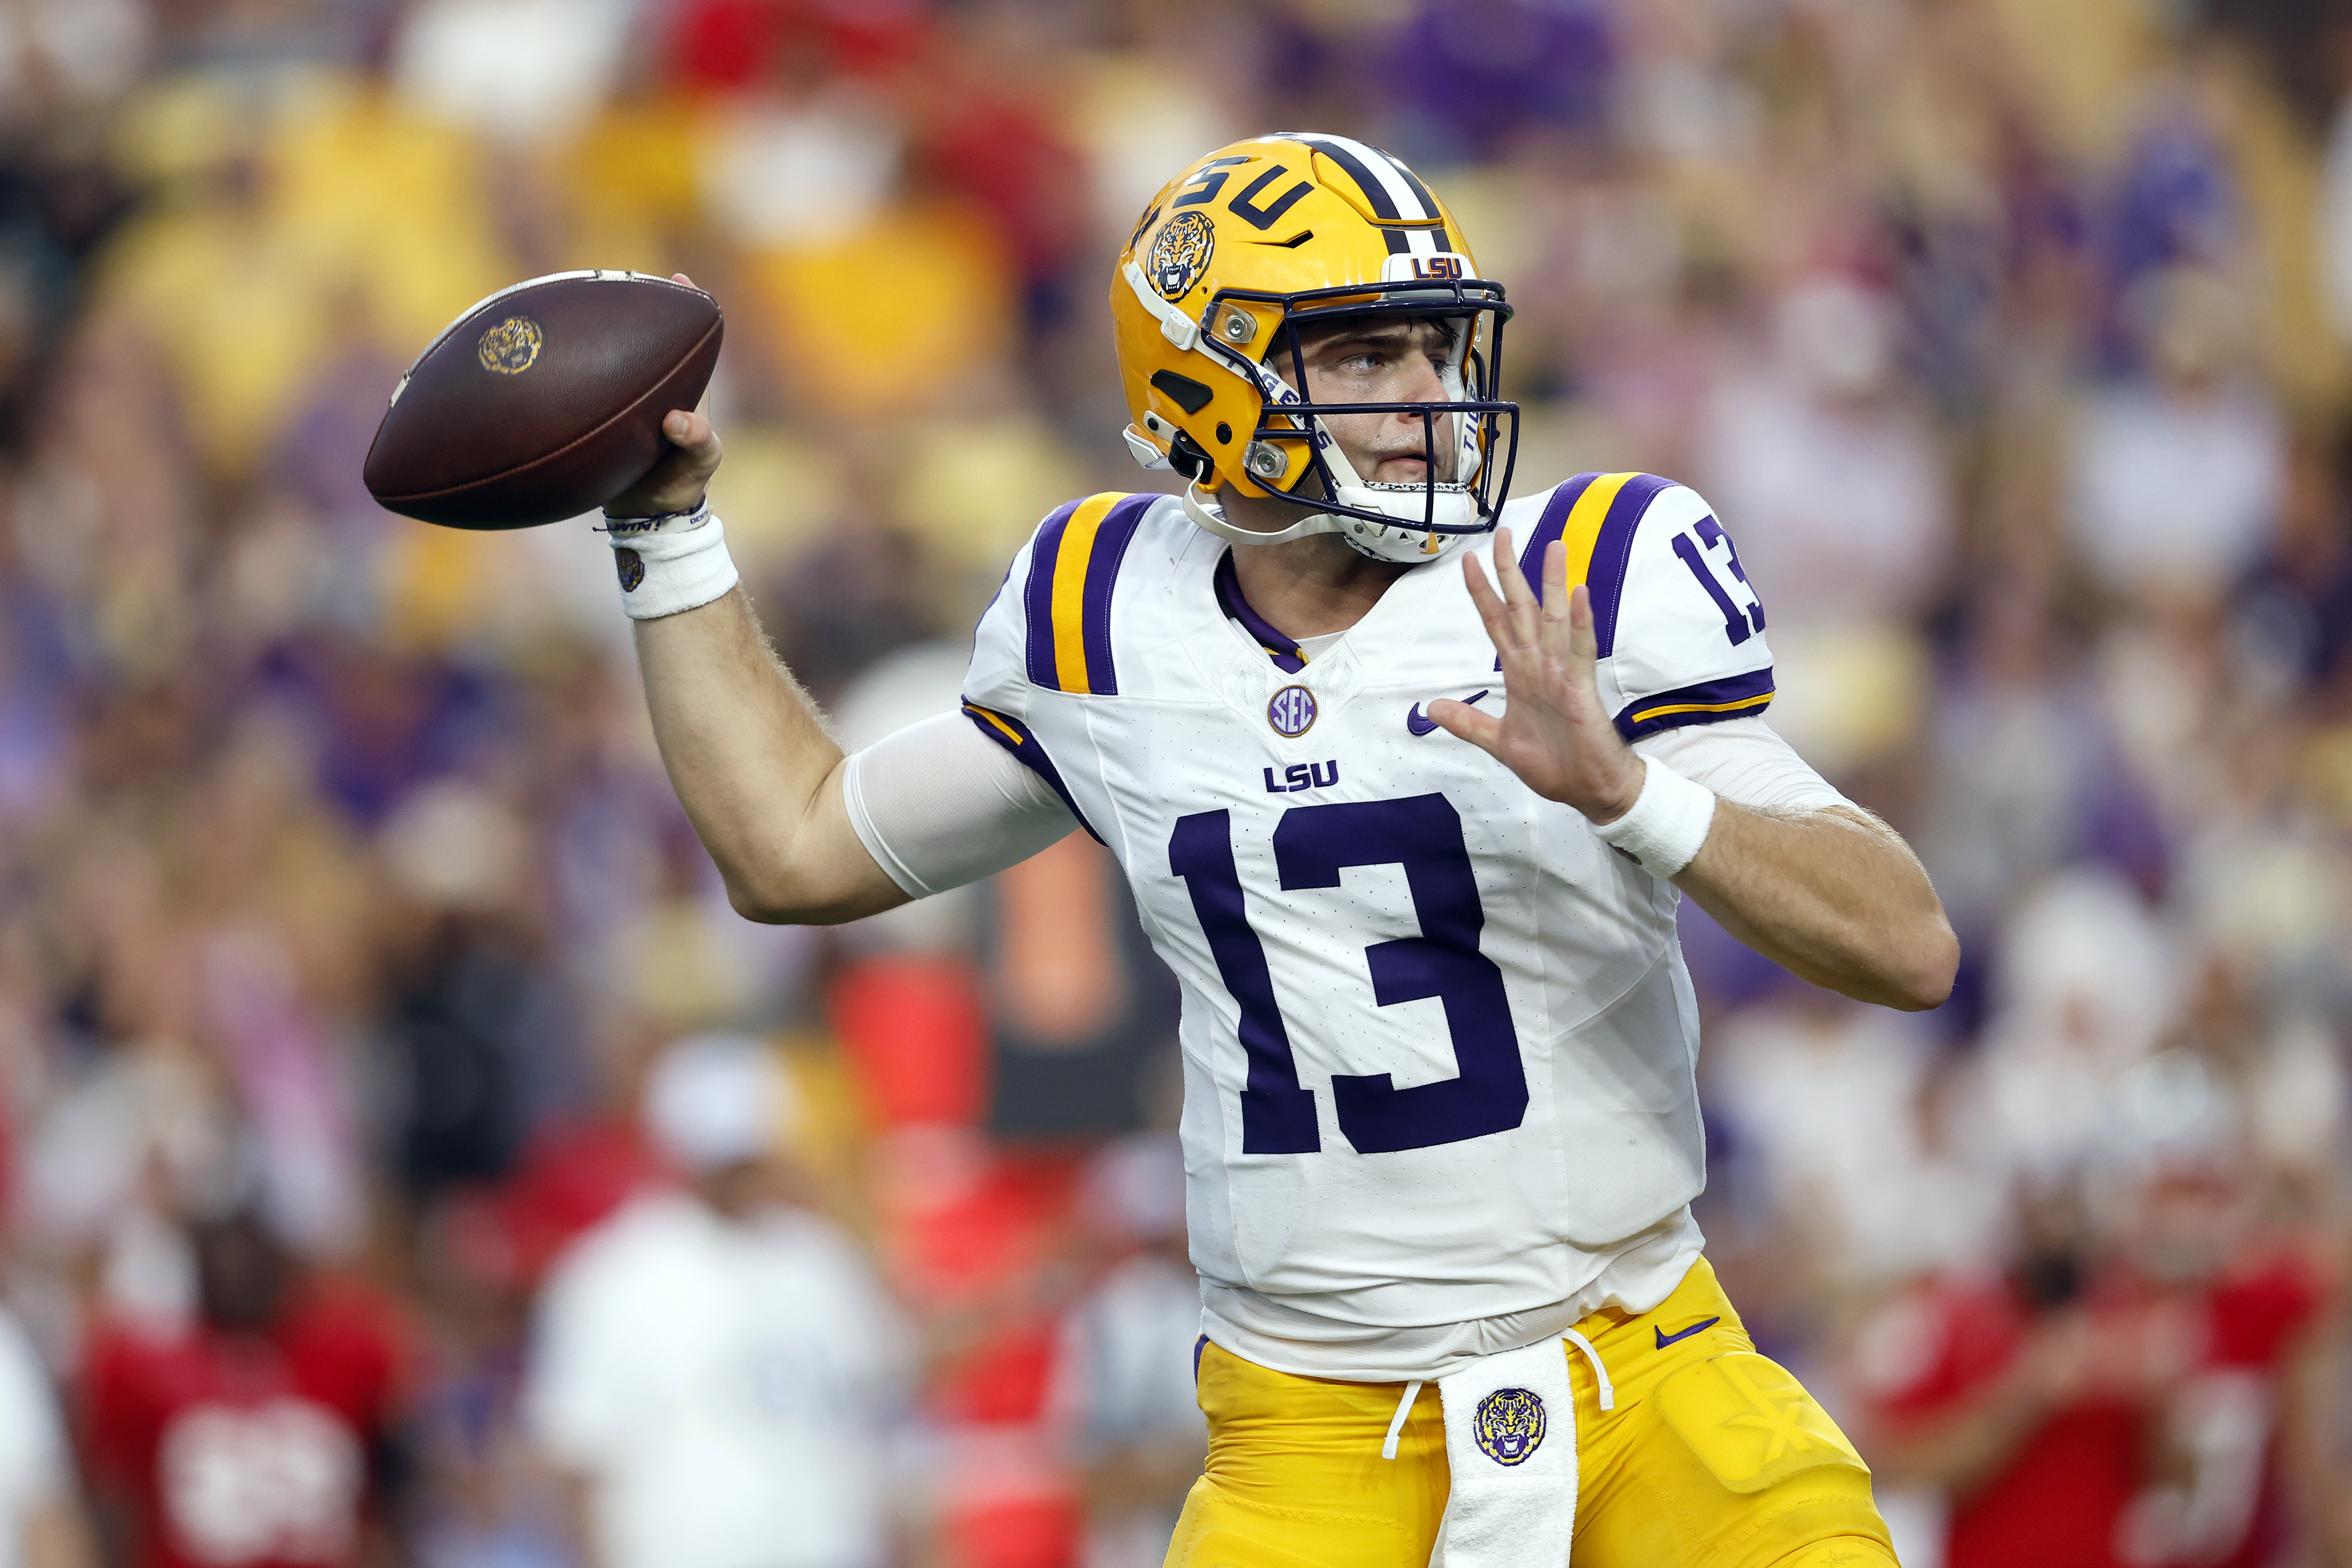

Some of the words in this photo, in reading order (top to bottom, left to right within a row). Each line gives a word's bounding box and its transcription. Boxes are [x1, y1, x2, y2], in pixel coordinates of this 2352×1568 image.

[1410, 258, 1463, 280] LSU
[1671, 514, 1765, 647] 13
[1273, 688, 1313, 732] SEC
[1263, 760, 1339, 793] LSU
[1169, 792, 1529, 1154] 13
